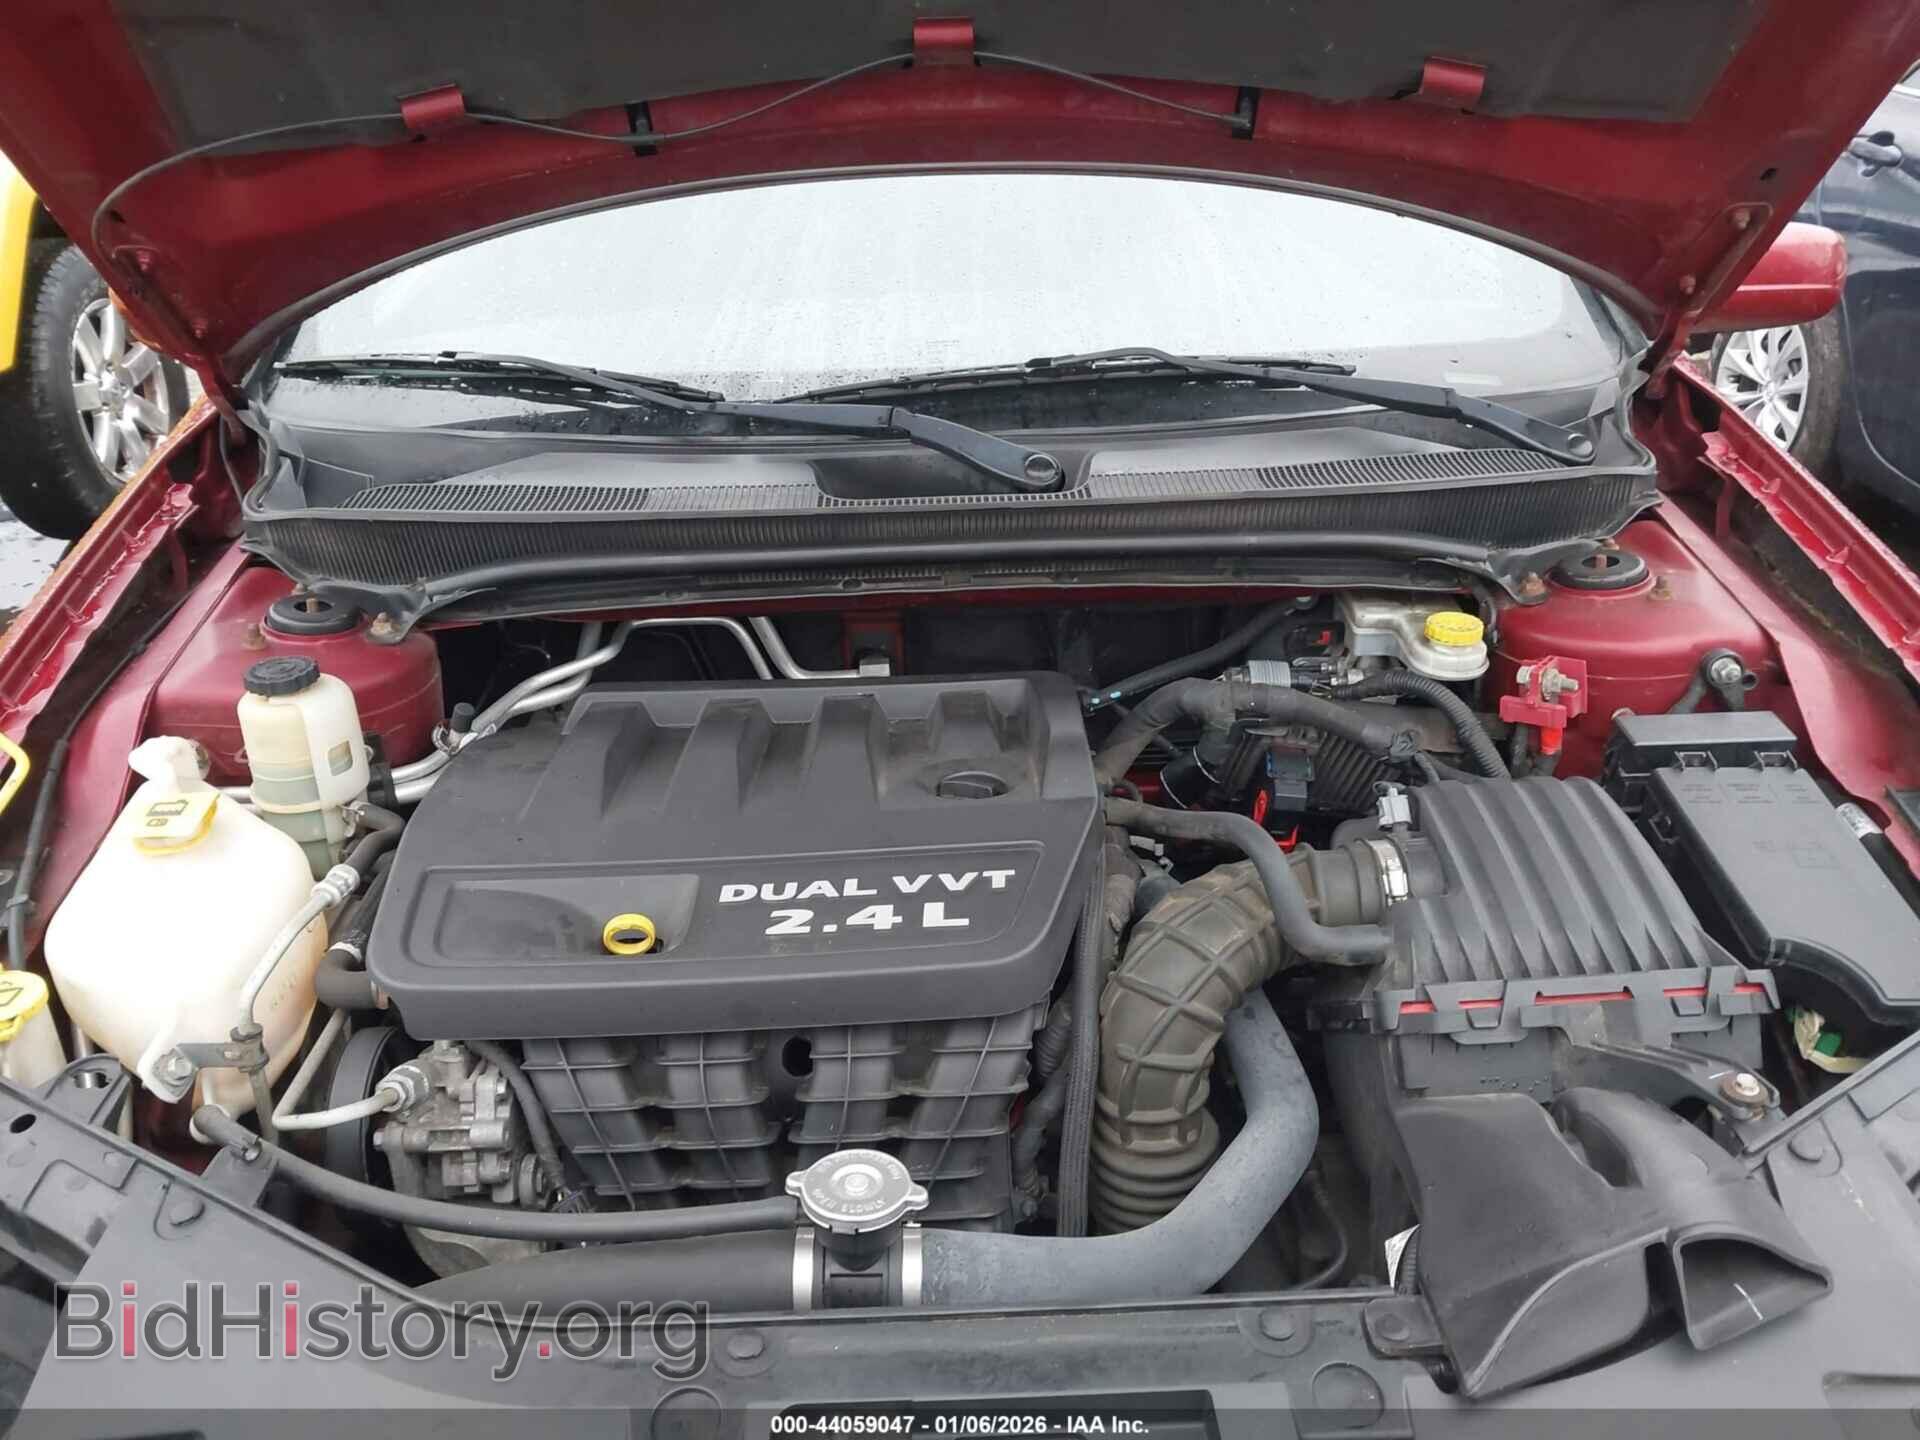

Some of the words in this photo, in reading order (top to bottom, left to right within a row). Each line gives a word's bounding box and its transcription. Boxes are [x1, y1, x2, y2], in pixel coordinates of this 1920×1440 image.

[719, 878, 878, 903] DUAL
[892, 869, 1016, 893] VVT
[765, 904, 903, 935] 2.4
[922, 902, 970, 928] L
